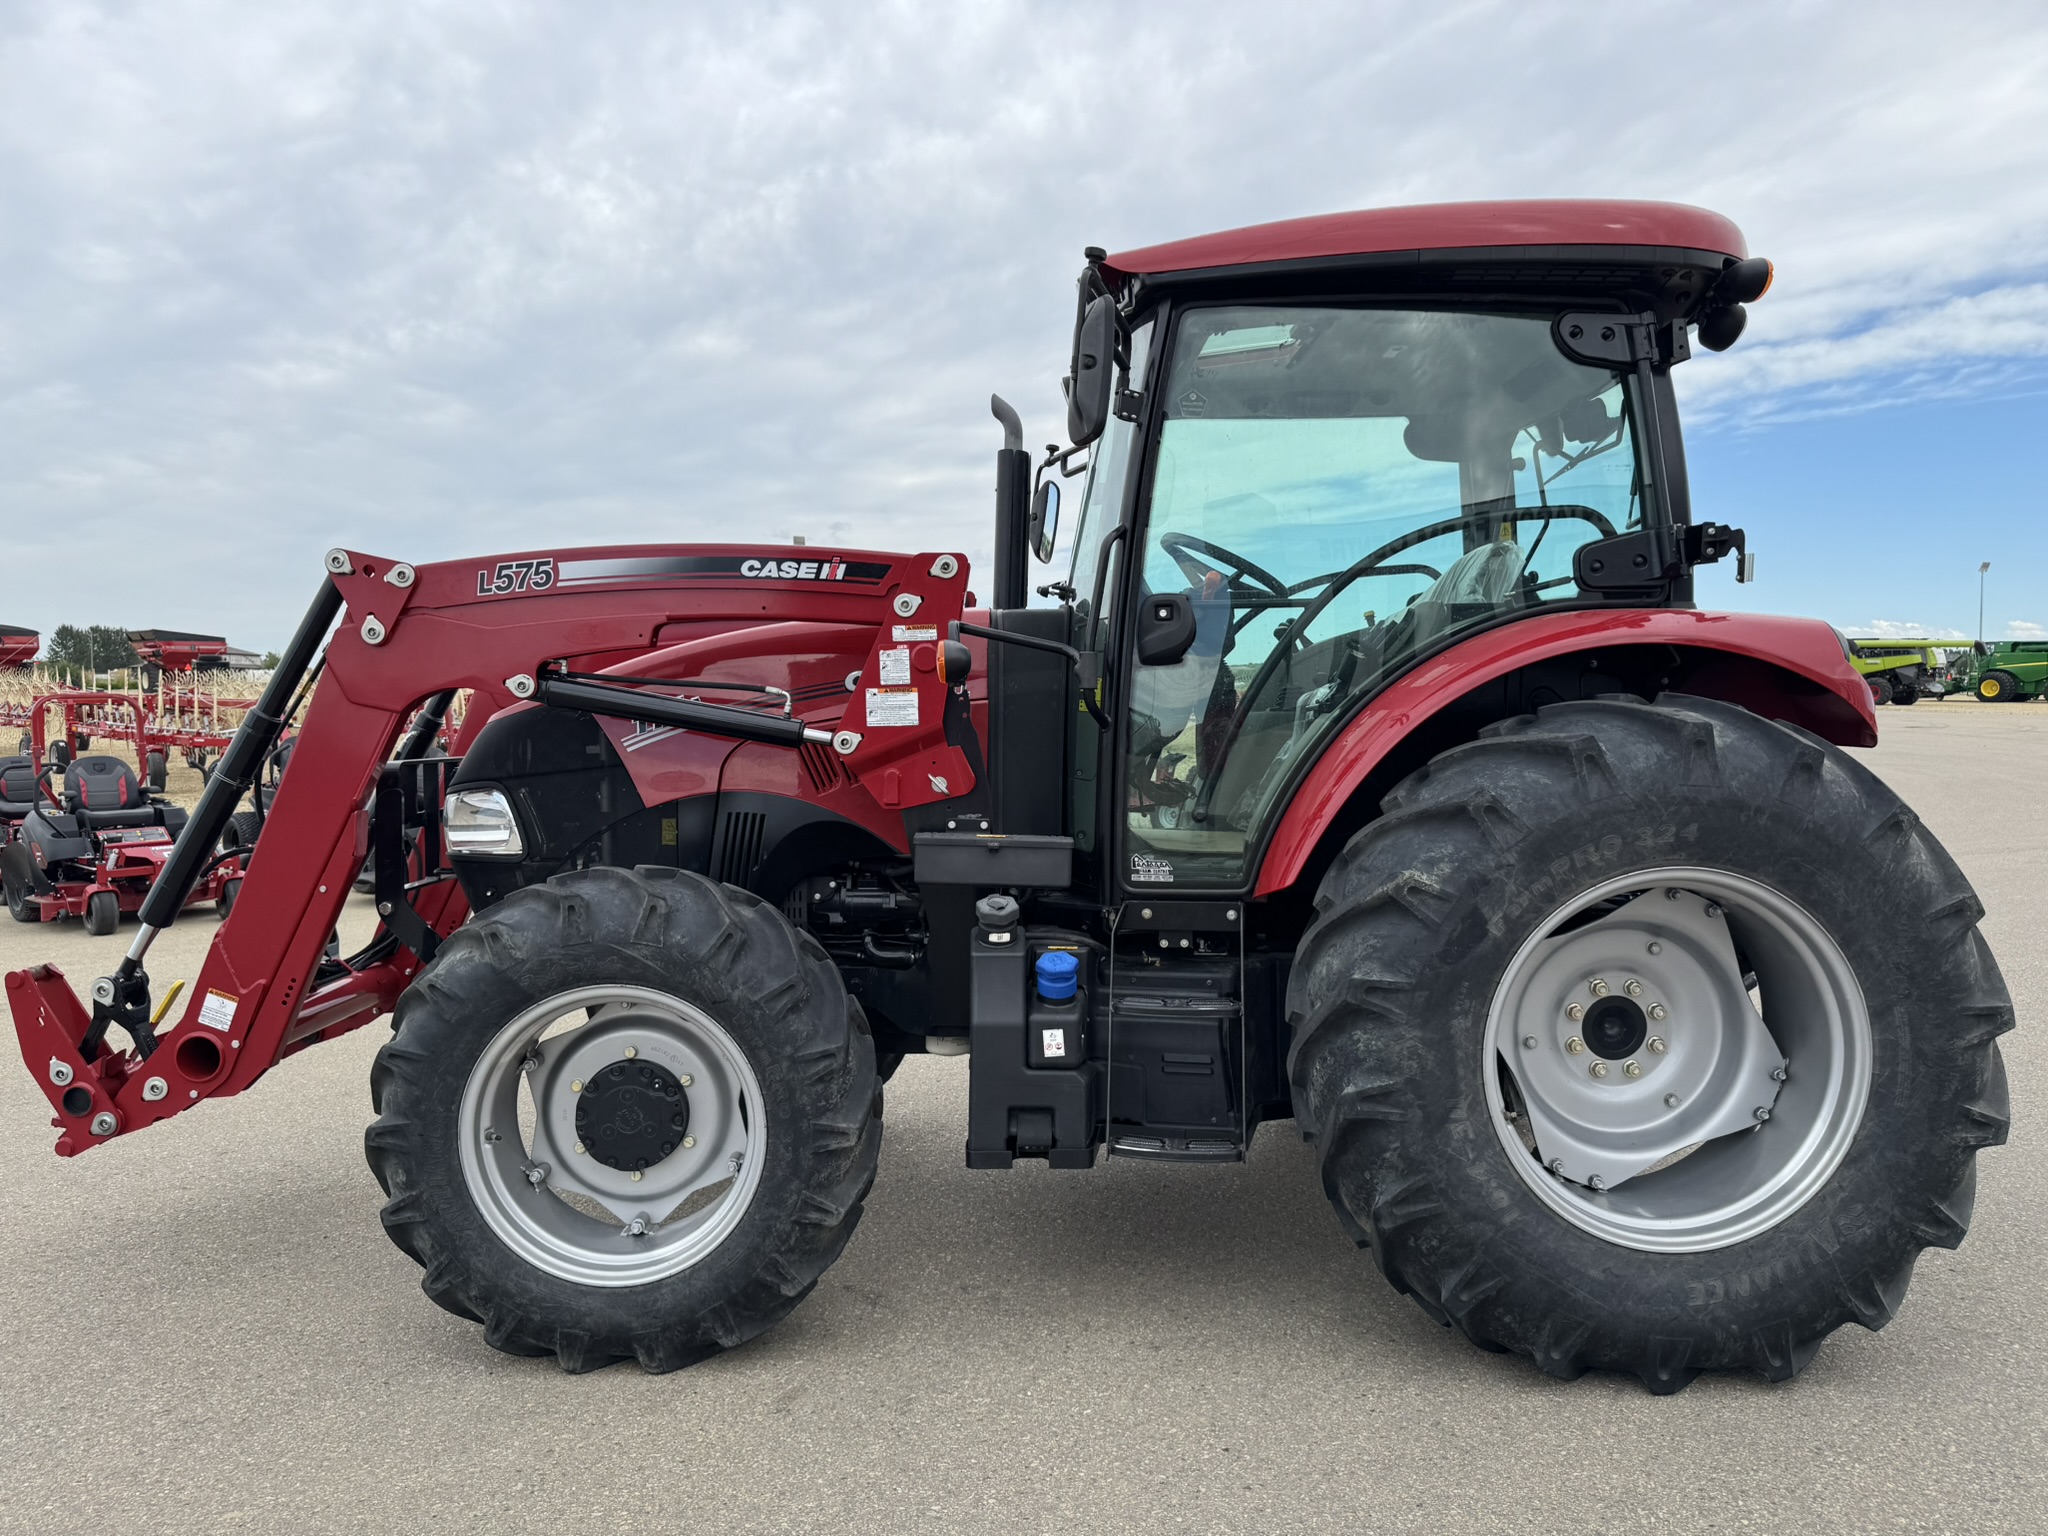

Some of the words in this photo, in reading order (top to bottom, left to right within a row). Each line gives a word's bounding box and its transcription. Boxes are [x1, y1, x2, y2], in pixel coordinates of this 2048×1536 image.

[477, 558, 553, 595] L575
[741, 559, 819, 579] CASE
[1636, 822, 1700, 848] 324
[1687, 1217, 1840, 1307] ALLIANCE
